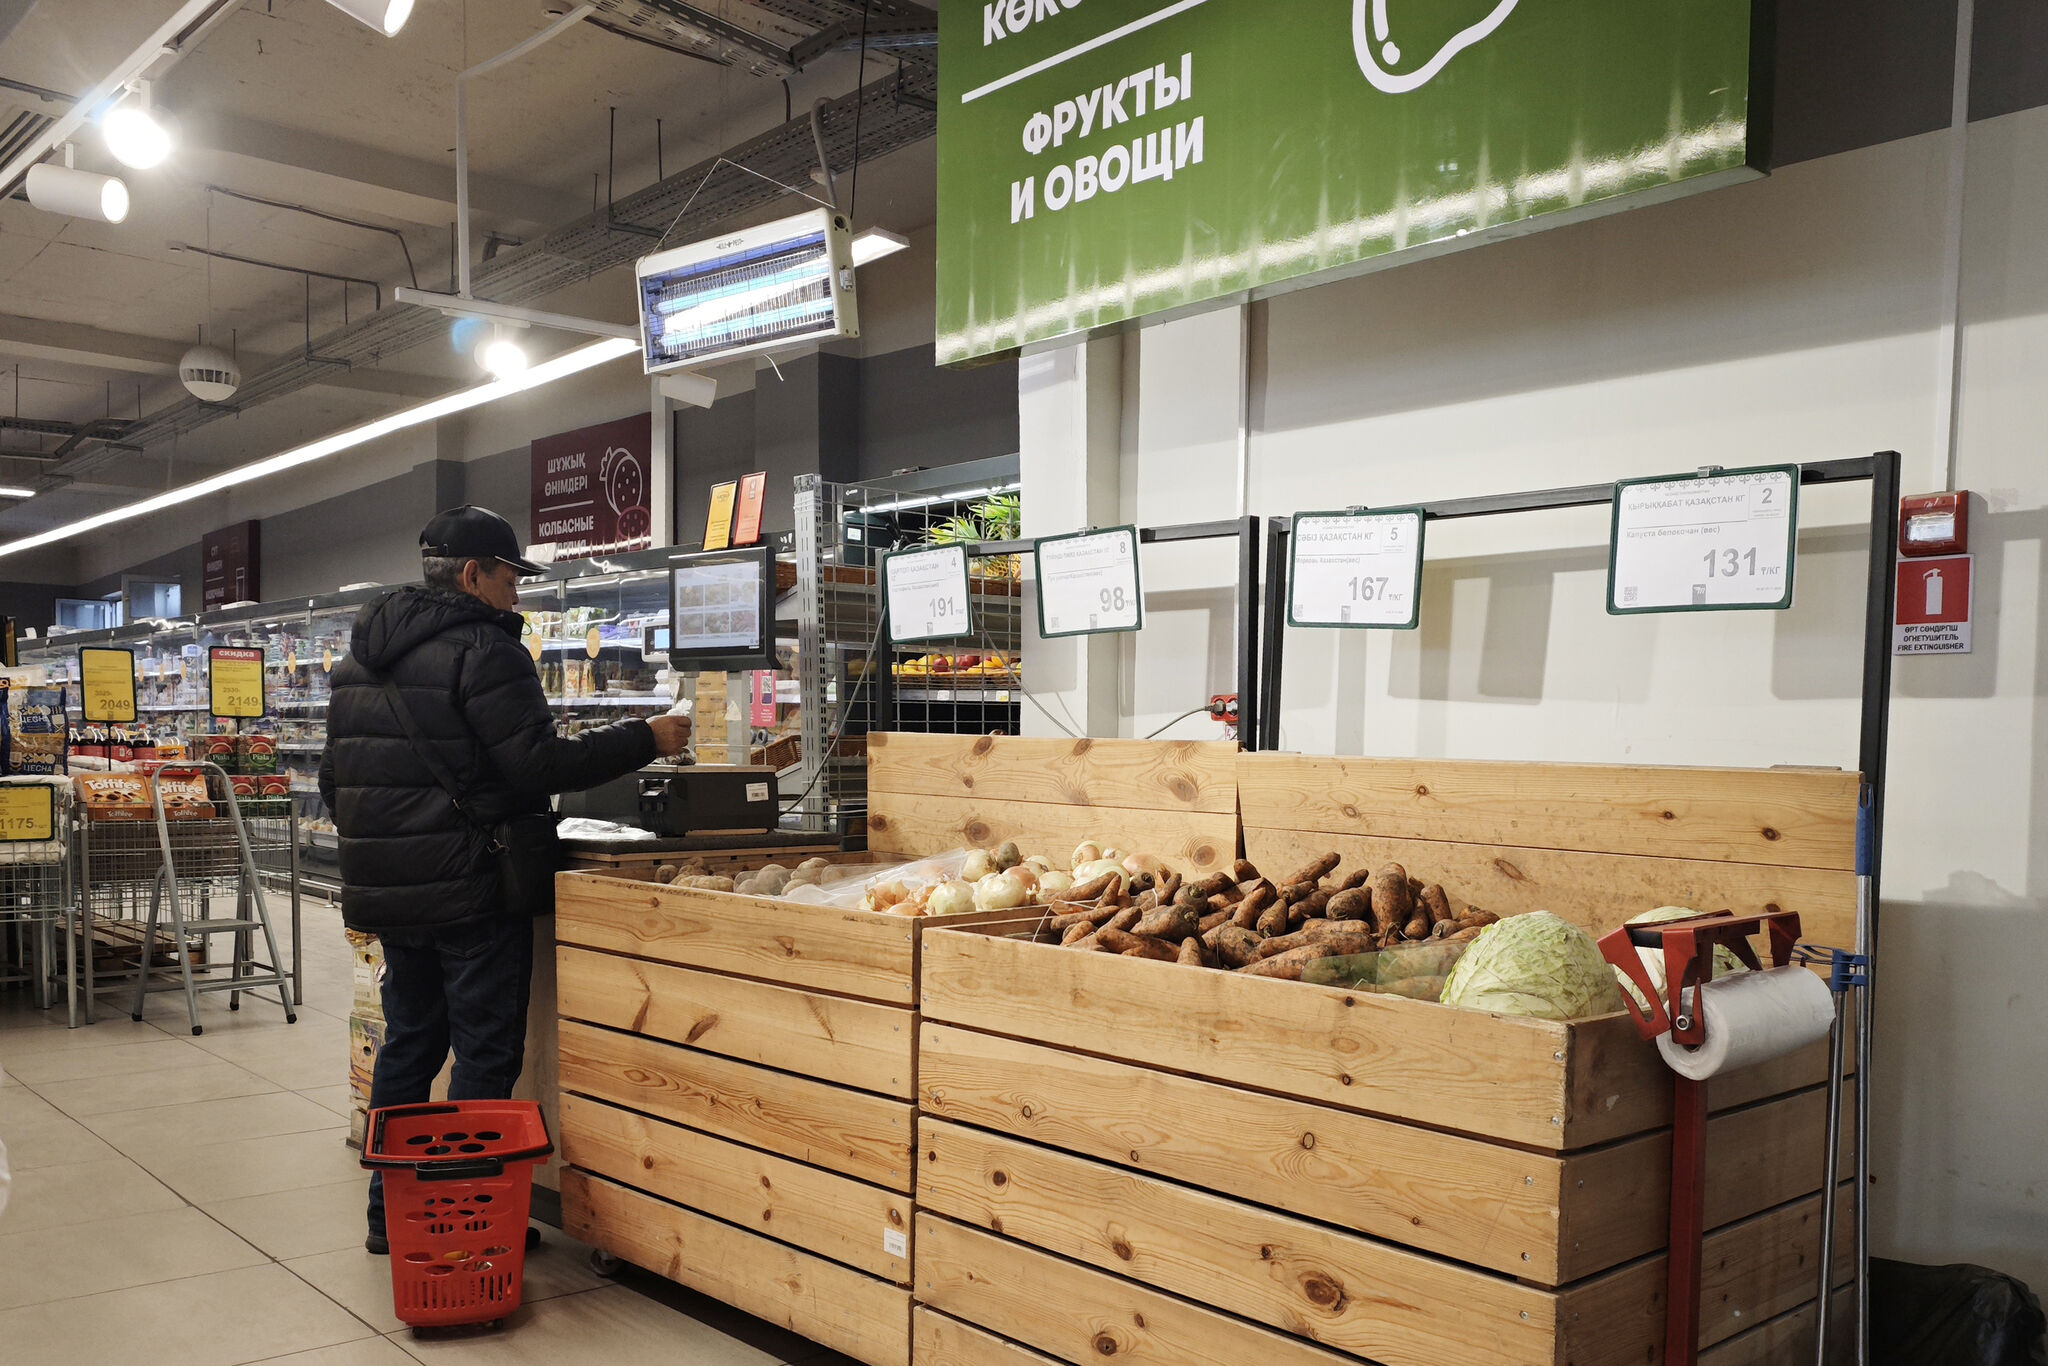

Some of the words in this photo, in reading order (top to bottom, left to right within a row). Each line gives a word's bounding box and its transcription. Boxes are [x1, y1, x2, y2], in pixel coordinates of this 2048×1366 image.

[983, 0, 1083, 46] КӨК
[1022, 52, 1192, 155] ФРУКТЫ
[1011, 175, 1035, 224] И
[1043, 115, 1204, 211] ОВОЩИ
[544, 475, 588, 497] ӨНІМДЕРІ
[1735, 494, 1745, 503] КГ
[1761, 487, 1773, 504] 2
[538, 515, 594, 537] КОЛБАСНЫЕ
[1390, 527, 1398, 541] 5
[1119, 541, 1126, 554] 8
[951, 557, 957, 567] 4
[1703, 547, 1757, 578] 131
[1348, 576, 1389, 601] 167
[1100, 586, 1125, 612] 98
[929, 596, 954, 618] 191
[1904, 626, 1918, 634] ӨРТ
[1903, 634, 1959, 642] ОГНЕТУШИТЕЛЬ
[1914, 642, 1964, 651] EXTINGUISHER
[100, 699, 130, 710] 2049
[227, 696, 259, 706] 2149
[85, 779, 142, 791] Toffifee
[160, 781, 203, 794] offifee
